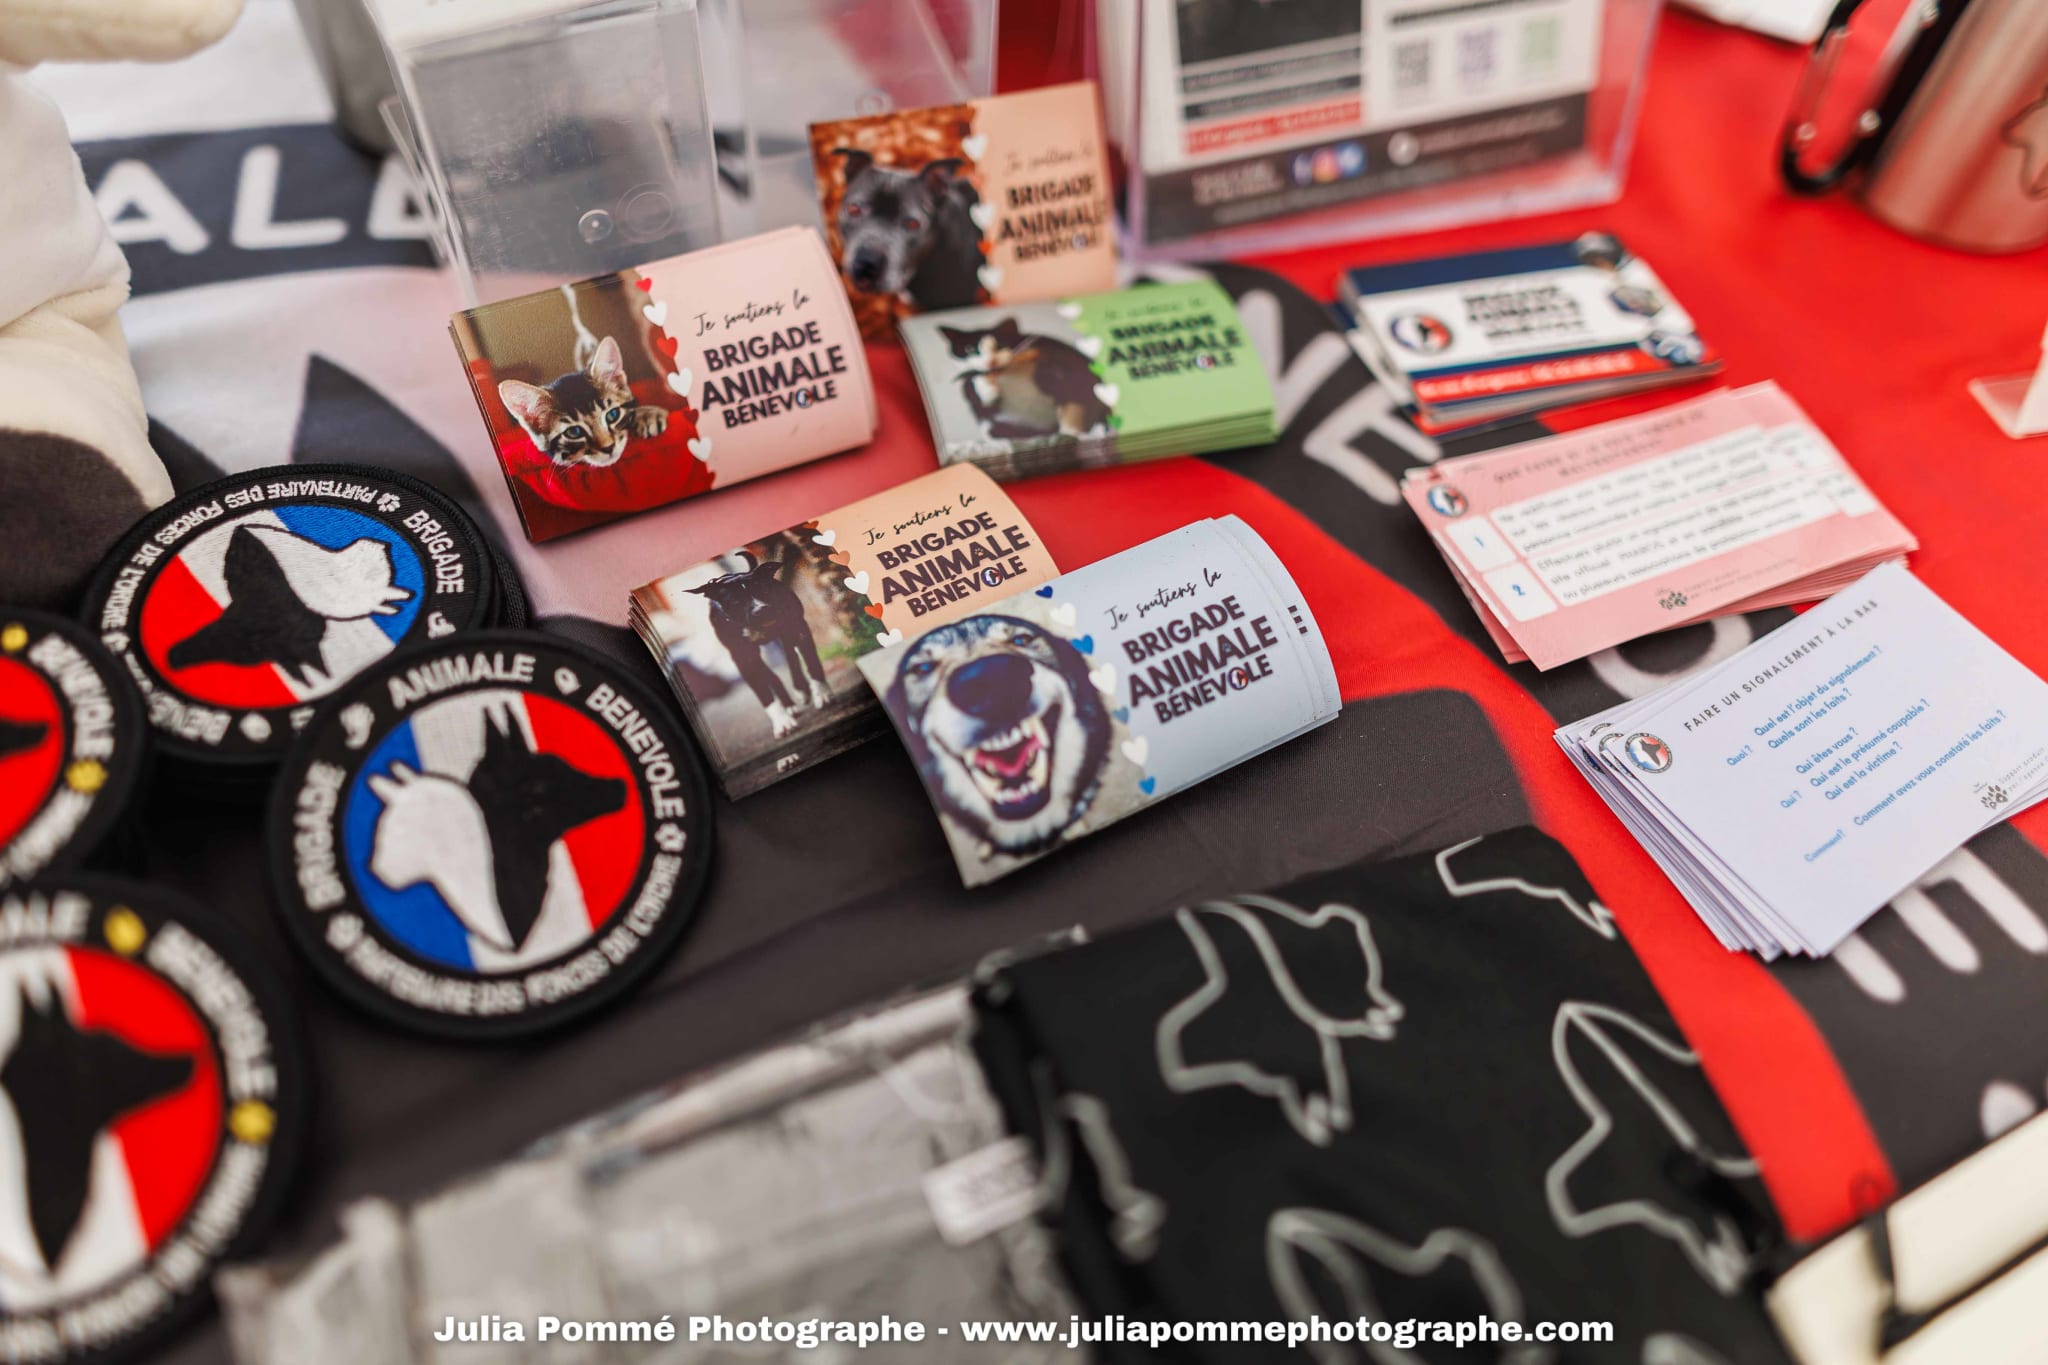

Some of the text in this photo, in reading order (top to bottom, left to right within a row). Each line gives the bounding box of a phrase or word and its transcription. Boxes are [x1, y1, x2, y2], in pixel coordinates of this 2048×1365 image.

[1007, 173, 1094, 209] BRIGADE
[999, 201, 1106, 241] ANIMALE
[693, 288, 810, 337] Je soutiens la
[1110, 313, 1216, 339] BRIGADE
[703, 321, 822, 373] BRIGADE
[1108, 326, 1243, 366] ANIMALE
[702, 345, 848, 412] ANIMALE
[722, 380, 838, 429] BÉNÉVOLE
[224, 484, 265, 509] DES
[267, 480, 378, 503] PARTENAIRE
[154, 500, 225, 545] FORCES
[862, 493, 976, 546] Je soutiens la
[876, 511, 998, 571] BRIGADE
[131, 542, 165, 567] DE
[402, 509, 465, 595] BRIGADE
[881, 525, 1031, 605] ANIMALE
[906, 555, 1028, 618] BÉNÉVOLE
[1104, 567, 1222, 630] Je soutiens la
[1511, 583, 1526, 597] 2
[1121, 595, 1245, 665] BRIGADE
[387, 652, 537, 710] ANIMALE
[1128, 615, 1279, 709] ANIMALE
[1154, 653, 1274, 725] BÉNÉVOLE
[1684, 704, 1721, 732] FAIRE
[1722, 690, 1741, 706] UN
[1742, 634, 1824, 693] SIGNALEMENT
[1825, 626, 1836, 638] À
[1837, 616, 1854, 630] LA
[1754, 717, 1777, 736] Quel
[1776, 709, 1790, 723] est
[1789, 690, 1817, 713] l'objet
[1817, 684, 1829, 695] du
[1828, 650, 1876, 687] signalement
[1768, 729, 1795, 749] Quels
[1794, 716, 1813, 732] sont
[1813, 706, 1827, 720] les
[1824, 693, 1847, 711] faits
[1810, 772, 1829, 788] Qui
[1828, 763, 1843, 777] est
[1841, 754, 1852, 766] le
[1851, 730, 1887, 762] présumé
[1886, 704, 1925, 735] coupable
[585, 683, 688, 820] BENEVOLE
[1726, 750, 1748, 766] Quoi
[1796, 759, 1815, 775] Qui
[1811, 748, 1833, 764] êtes
[1832, 734, 1854, 751] vous
[1824, 785, 1843, 801] Qui
[1842, 776, 1858, 790] est
[1856, 767, 1867, 779] la
[1864, 746, 1897, 772] victime
[1853, 793, 1897, 826] Comment
[1895, 779, 1917, 797] avez
[1915, 765, 1936, 782] vous
[1935, 737, 1970, 767] constaté
[1967, 729, 1983, 743] les
[1979, 714, 2001, 735] faits
[1780, 795, 1798, 809] Qui
[292, 758, 347, 911] BRIGADE
